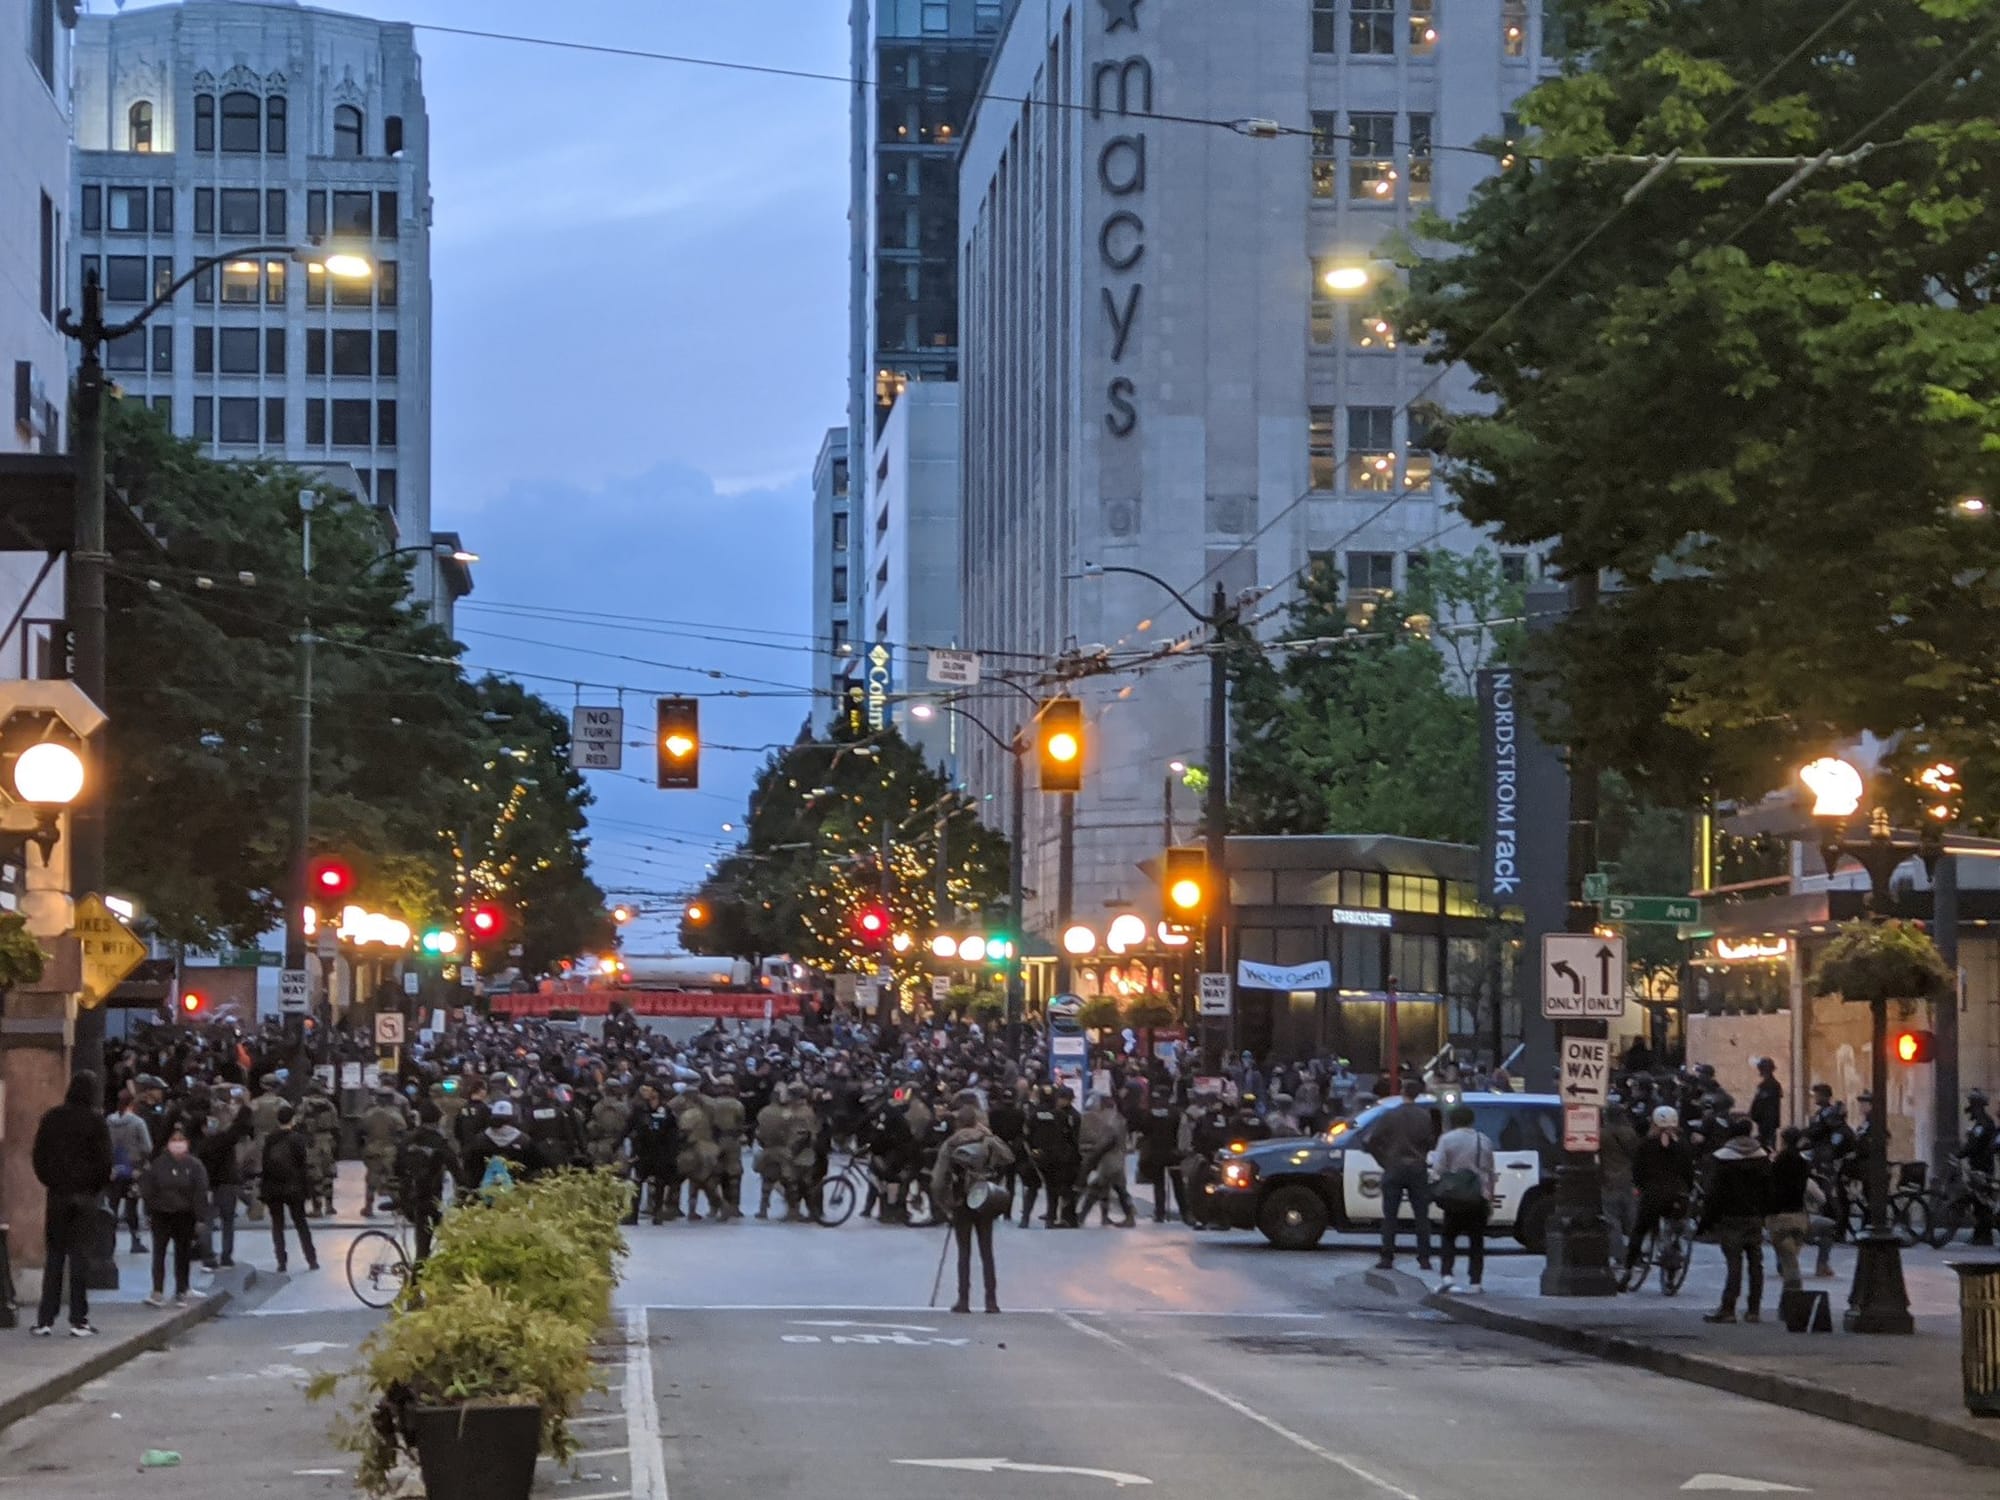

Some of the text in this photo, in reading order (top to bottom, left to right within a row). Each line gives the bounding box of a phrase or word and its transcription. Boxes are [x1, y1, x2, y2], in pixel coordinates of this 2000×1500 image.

[1092, 54, 1153, 440] macys
[587, 711, 609, 725] NO
[584, 727, 612, 738] TURN
[589, 741, 605, 752] ON
[586, 754, 608, 766] RED
[1492, 673, 1521, 894] NORDSTROM rack
[1665, 904, 1691, 918] Ave
[282, 974, 305, 984] ONE
[1203, 977, 1226, 987] ONE
[282, 985, 305, 995] WAY
[1203, 988, 1225, 998] WAY
[1548, 998, 1621, 1010] ONLY ONLY
[1568, 1044, 1603, 1061] ONE
[1566, 1062, 1604, 1080] WAY
